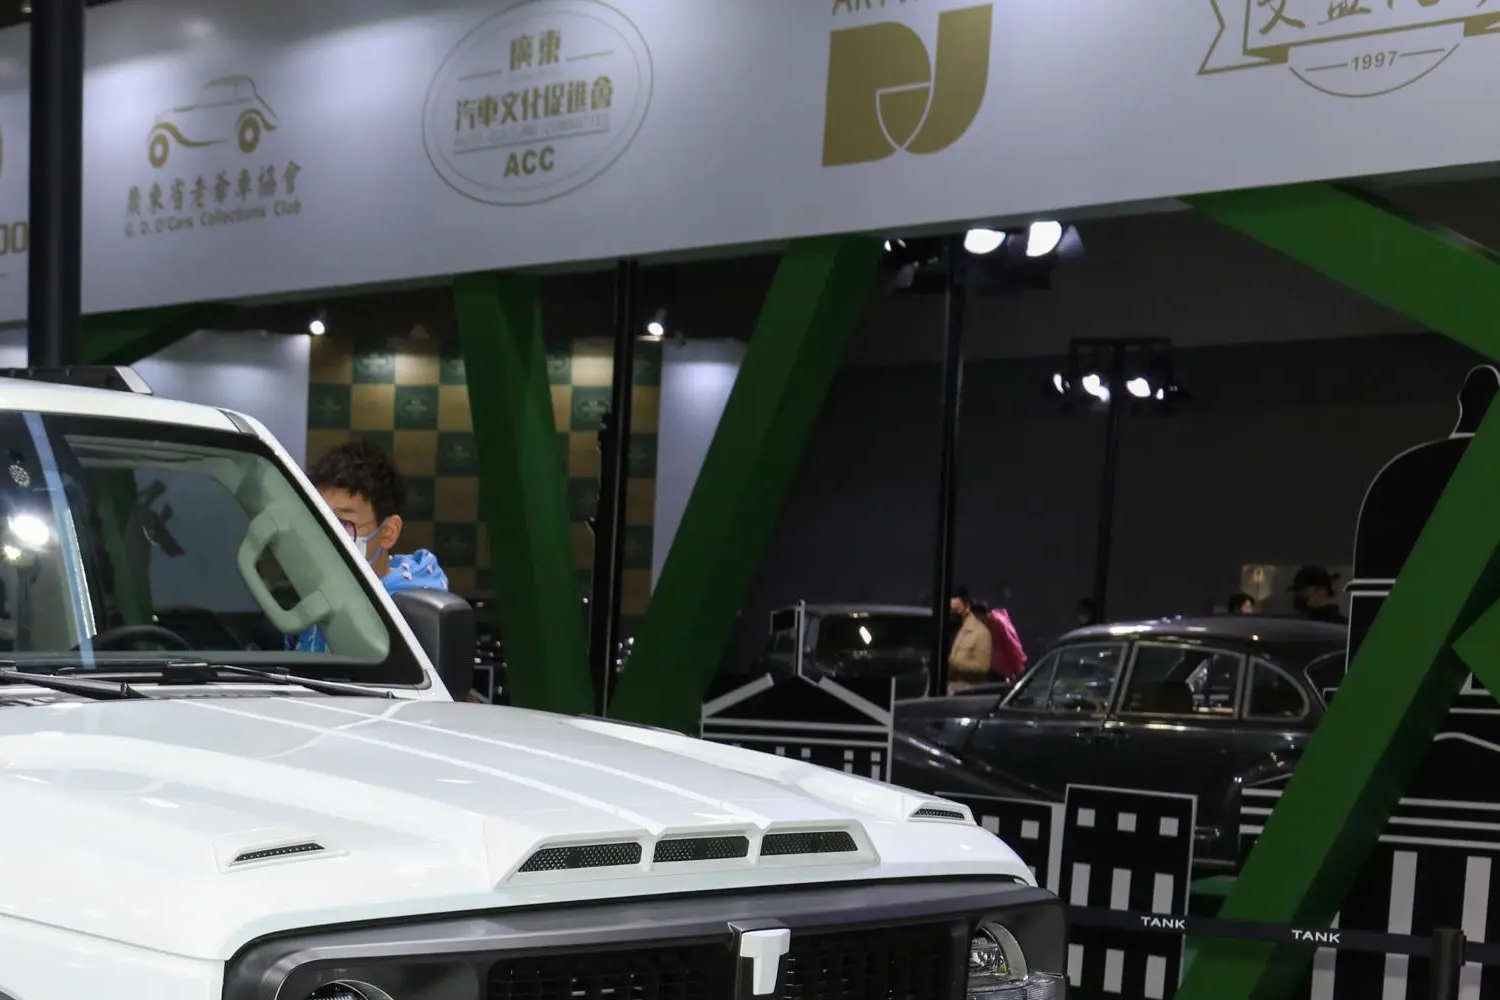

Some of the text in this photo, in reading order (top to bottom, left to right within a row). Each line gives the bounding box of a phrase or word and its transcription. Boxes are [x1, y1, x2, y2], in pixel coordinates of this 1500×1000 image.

[1351, 50, 1398, 72] 1997
[503, 145, 556, 179] ACC
[1140, 916, 1186, 930] TANK
[1291, 929, 1341, 944] TANK
